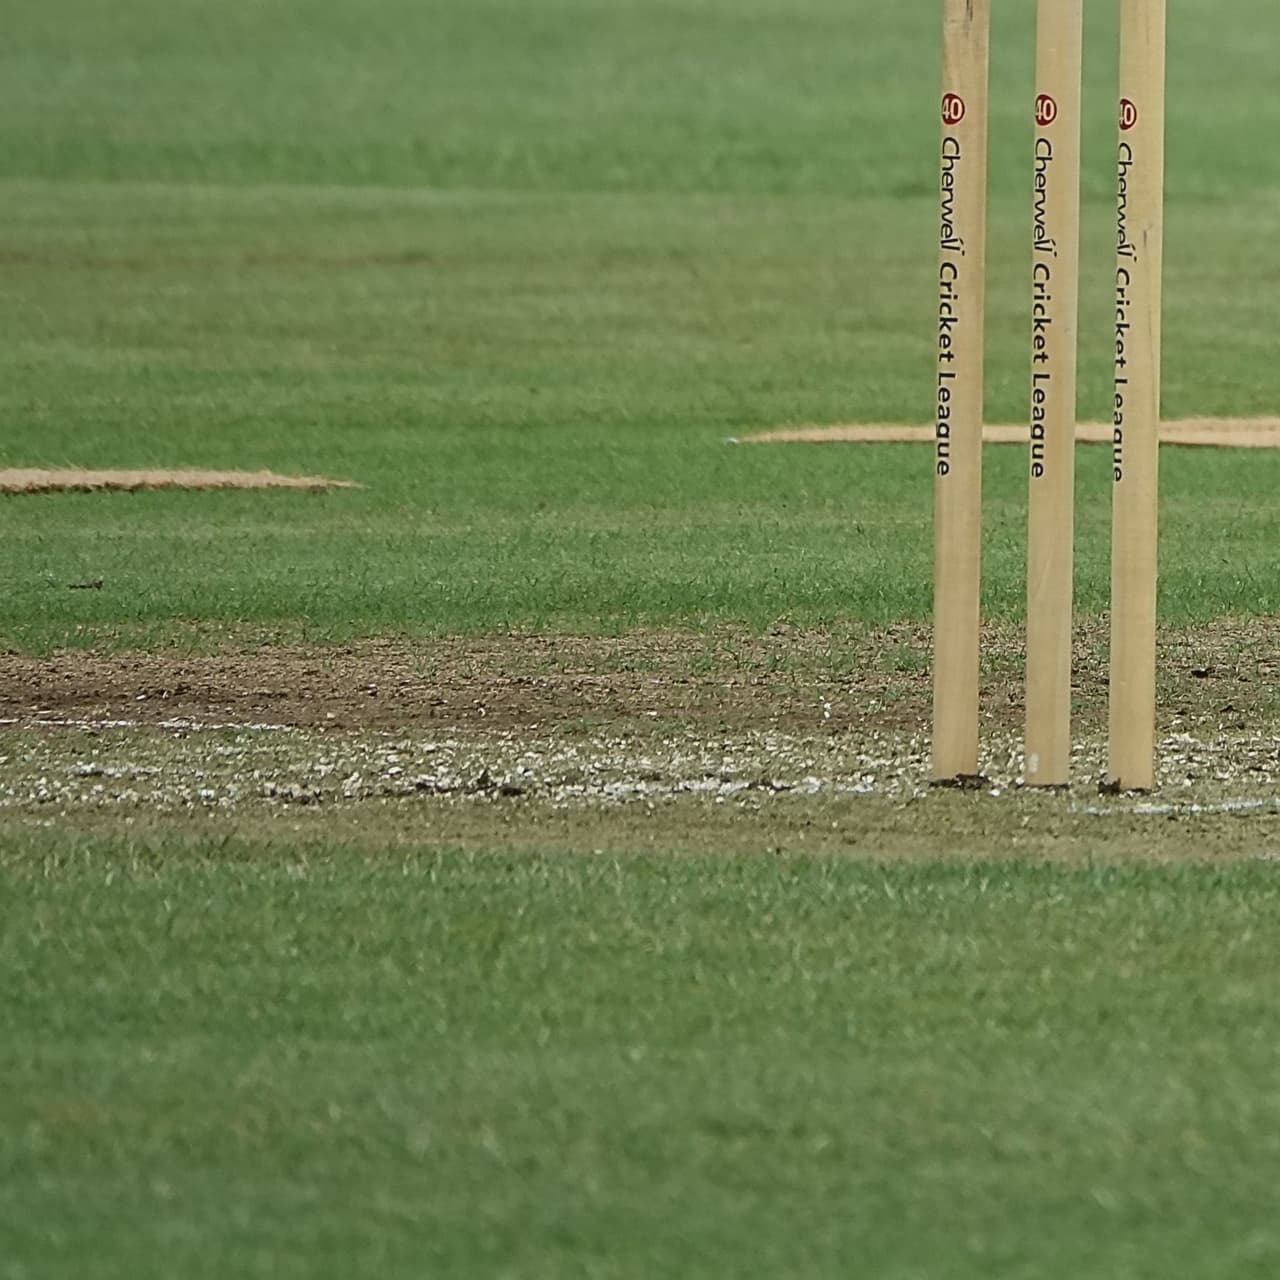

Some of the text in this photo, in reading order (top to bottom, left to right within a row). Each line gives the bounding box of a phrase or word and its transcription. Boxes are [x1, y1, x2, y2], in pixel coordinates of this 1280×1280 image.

[943, 98, 963, 120] 40
[936, 137, 963, 476] Cherwell Cricket League
[1031, 138, 1055, 478] Cherwell Cricket League
[1115, 267, 1130, 368] Cricket
